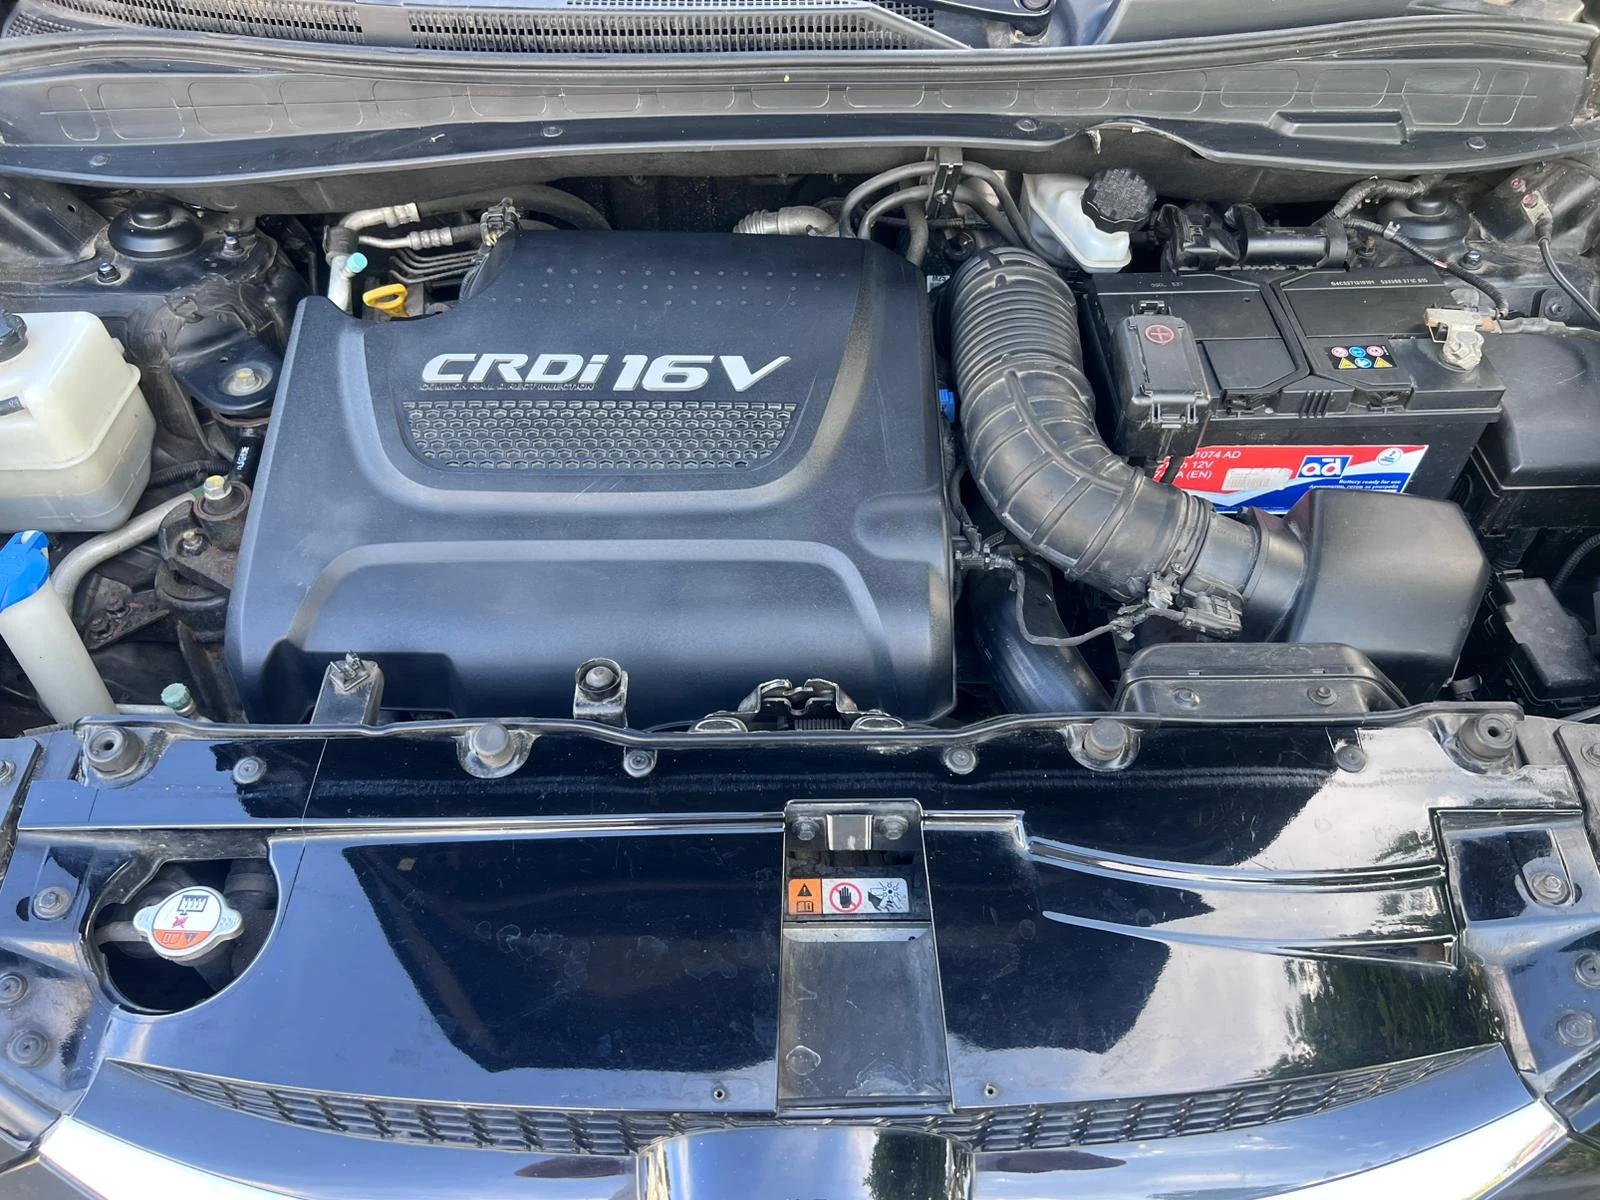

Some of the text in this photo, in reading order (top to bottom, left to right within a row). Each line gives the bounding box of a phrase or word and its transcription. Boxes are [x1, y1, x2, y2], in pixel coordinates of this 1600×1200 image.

[420, 353, 792, 393] CRDi 16V
[1222, 450, 1242, 459] AD
[1192, 460, 1214, 469] 12V
[1186, 470, 1212, 480] (EN)
